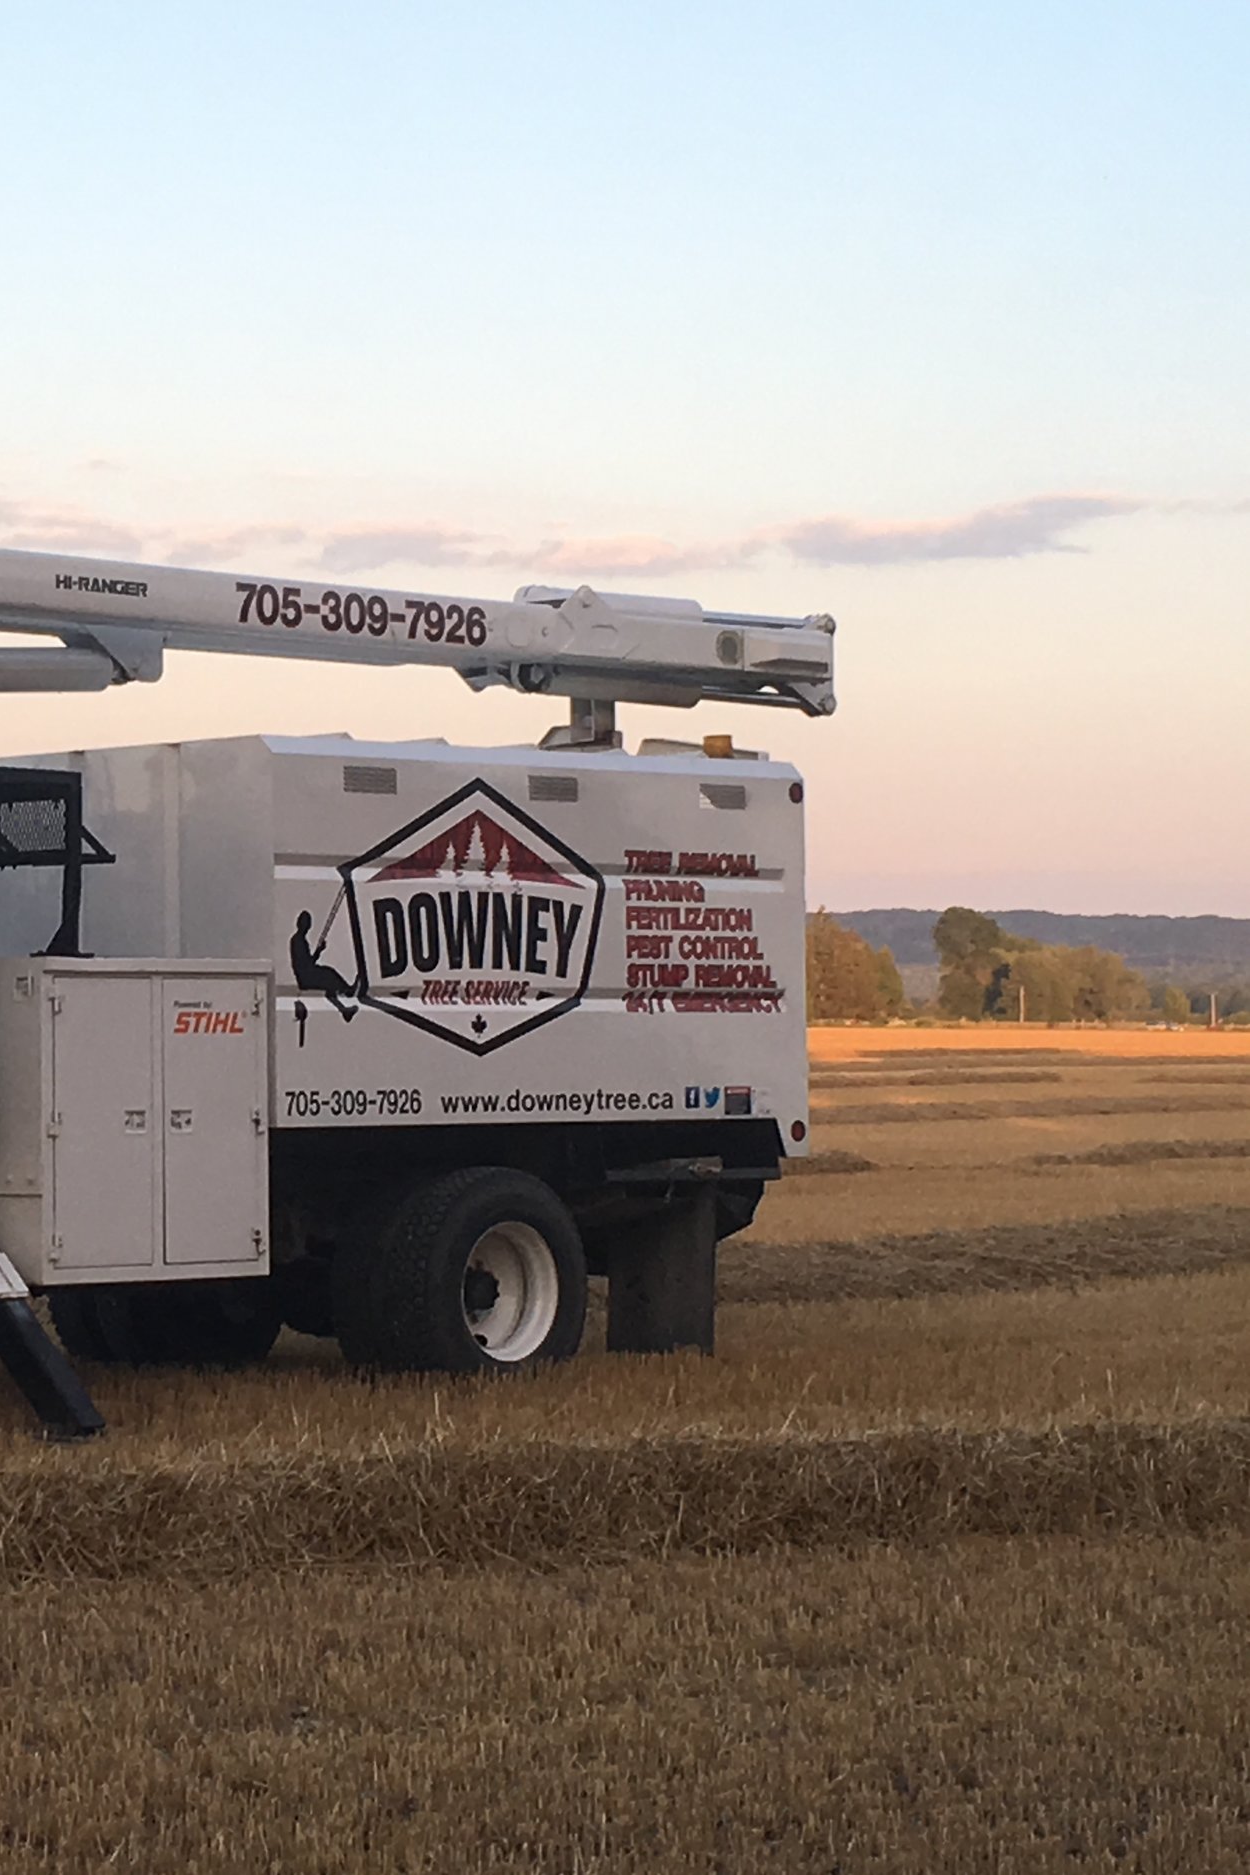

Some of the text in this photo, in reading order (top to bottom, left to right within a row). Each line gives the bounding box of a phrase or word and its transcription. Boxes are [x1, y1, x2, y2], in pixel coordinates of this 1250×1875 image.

[55, 574, 148, 597] HI-RANGER
[236, 581, 488, 647] 705-309-7926
[624, 849, 759, 877] TREE REMOVAL
[622, 879, 705, 903] PRUNING
[626, 906, 752, 932] FERTILIZATION
[372, 891, 584, 980] DOWNEY
[626, 935, 764, 961] PEST CONTROL
[627, 963, 777, 989] STUMP REMOVAL
[421, 979, 530, 1005] TREE SERVICE
[174, 1011, 244, 1034] STIHL
[285, 1089, 422, 1116] 705-309-7926
[441, 1088, 674, 1116] www.downeytree.ca
